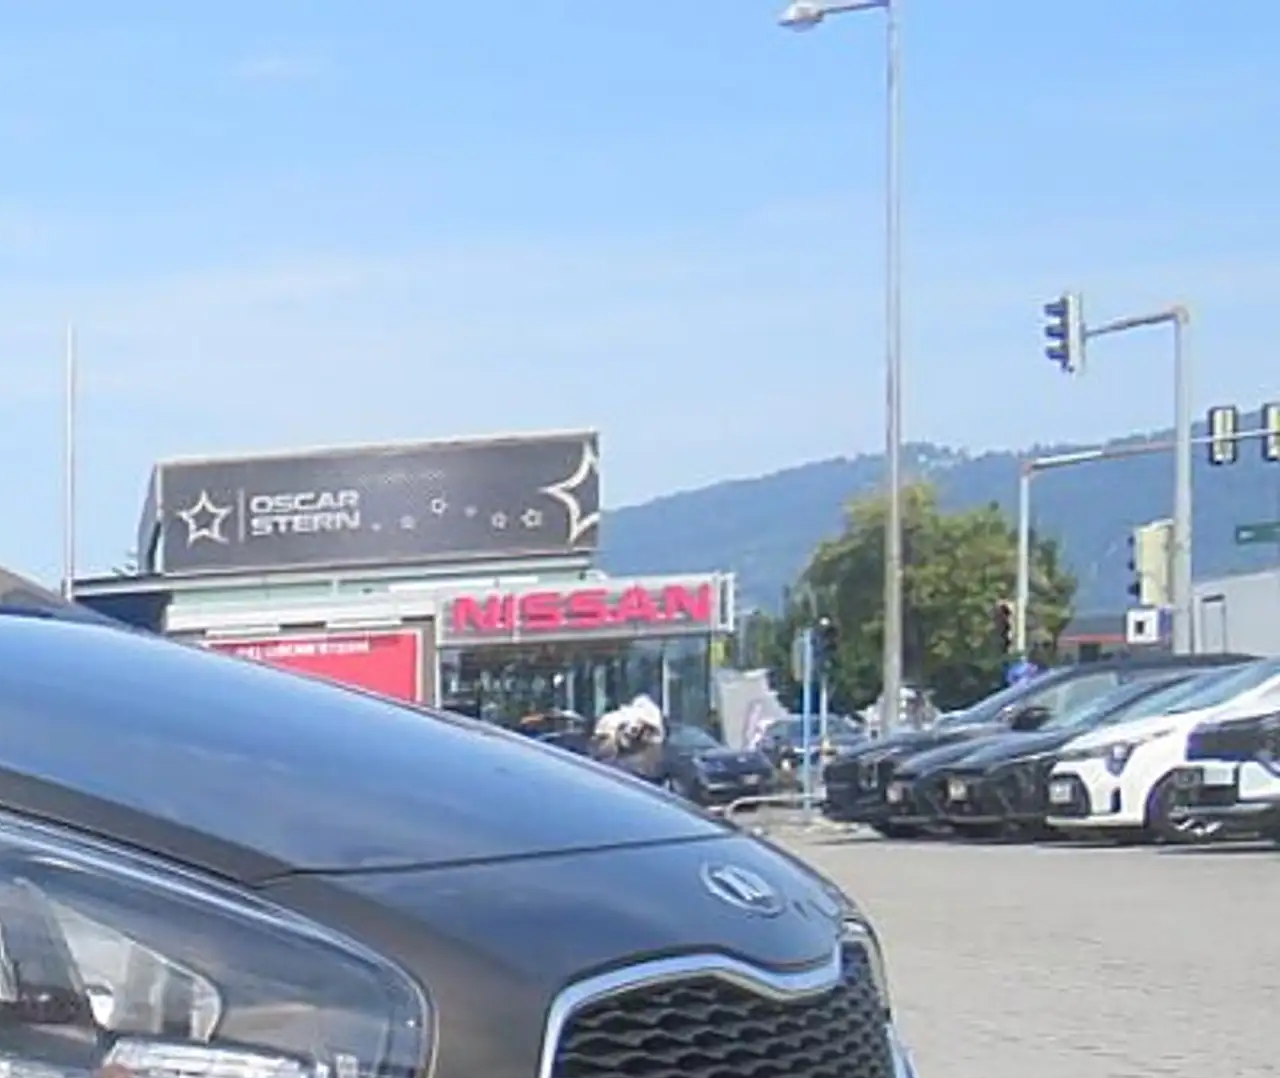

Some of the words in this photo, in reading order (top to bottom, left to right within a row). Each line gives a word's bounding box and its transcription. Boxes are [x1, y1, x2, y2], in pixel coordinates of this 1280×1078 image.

[250, 490, 360, 513] OSCAR
[250, 511, 361, 536] STERN
[451, 582, 713, 634] NISSAN
